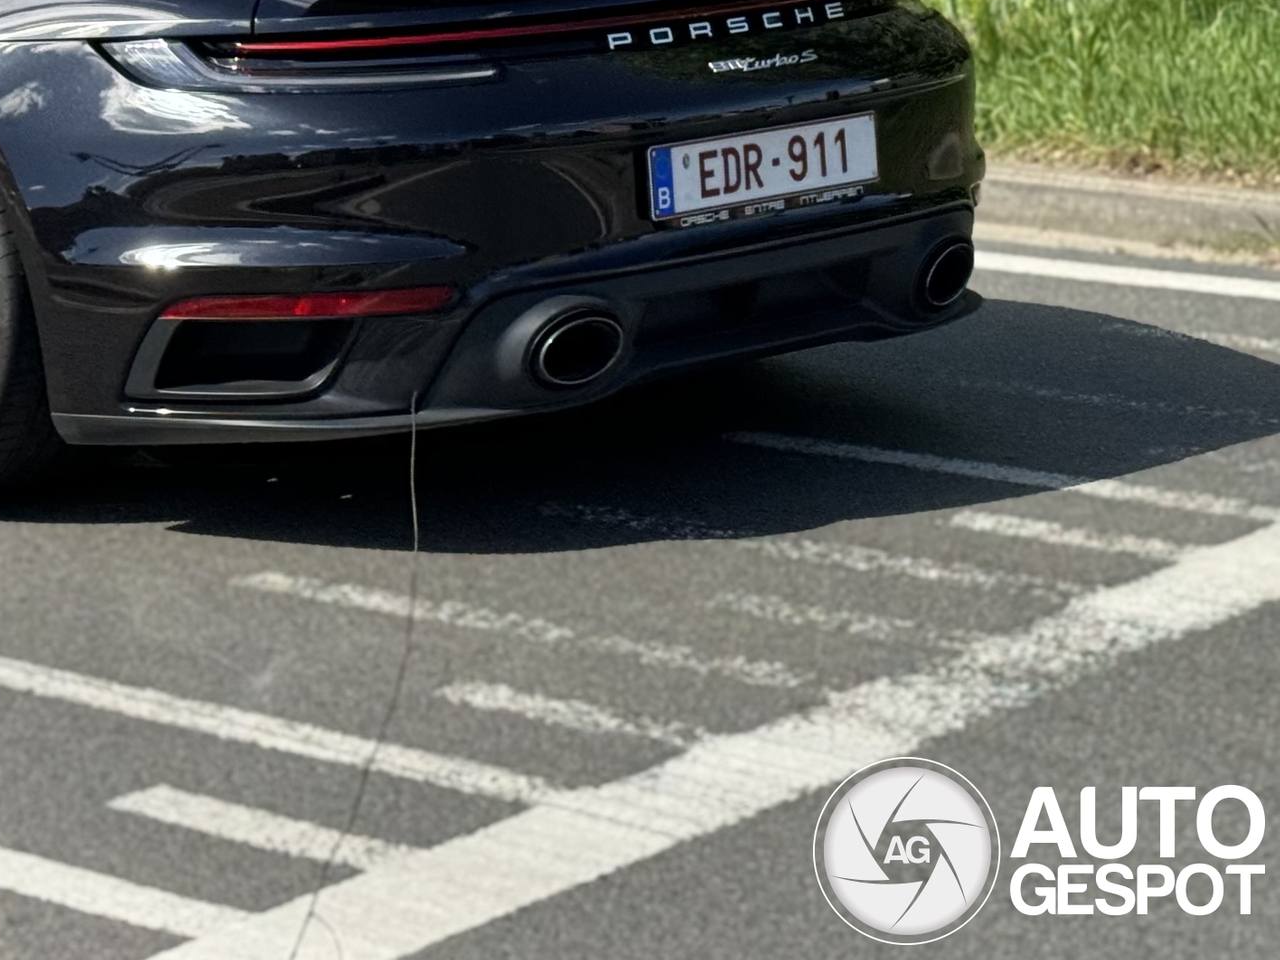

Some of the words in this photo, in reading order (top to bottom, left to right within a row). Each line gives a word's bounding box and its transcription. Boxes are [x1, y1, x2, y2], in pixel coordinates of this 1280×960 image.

[607, 2, 845, 49] PORSCHE
[800, 48, 818, 63] S
[698, 128, 848, 199] EDR-911
[657, 187, 671, 209] B
[674, 209, 730, 228] ORSCHE
[738, 199, 785, 216] ENTRE
[792, 185, 864, 206] NTWERPEN
